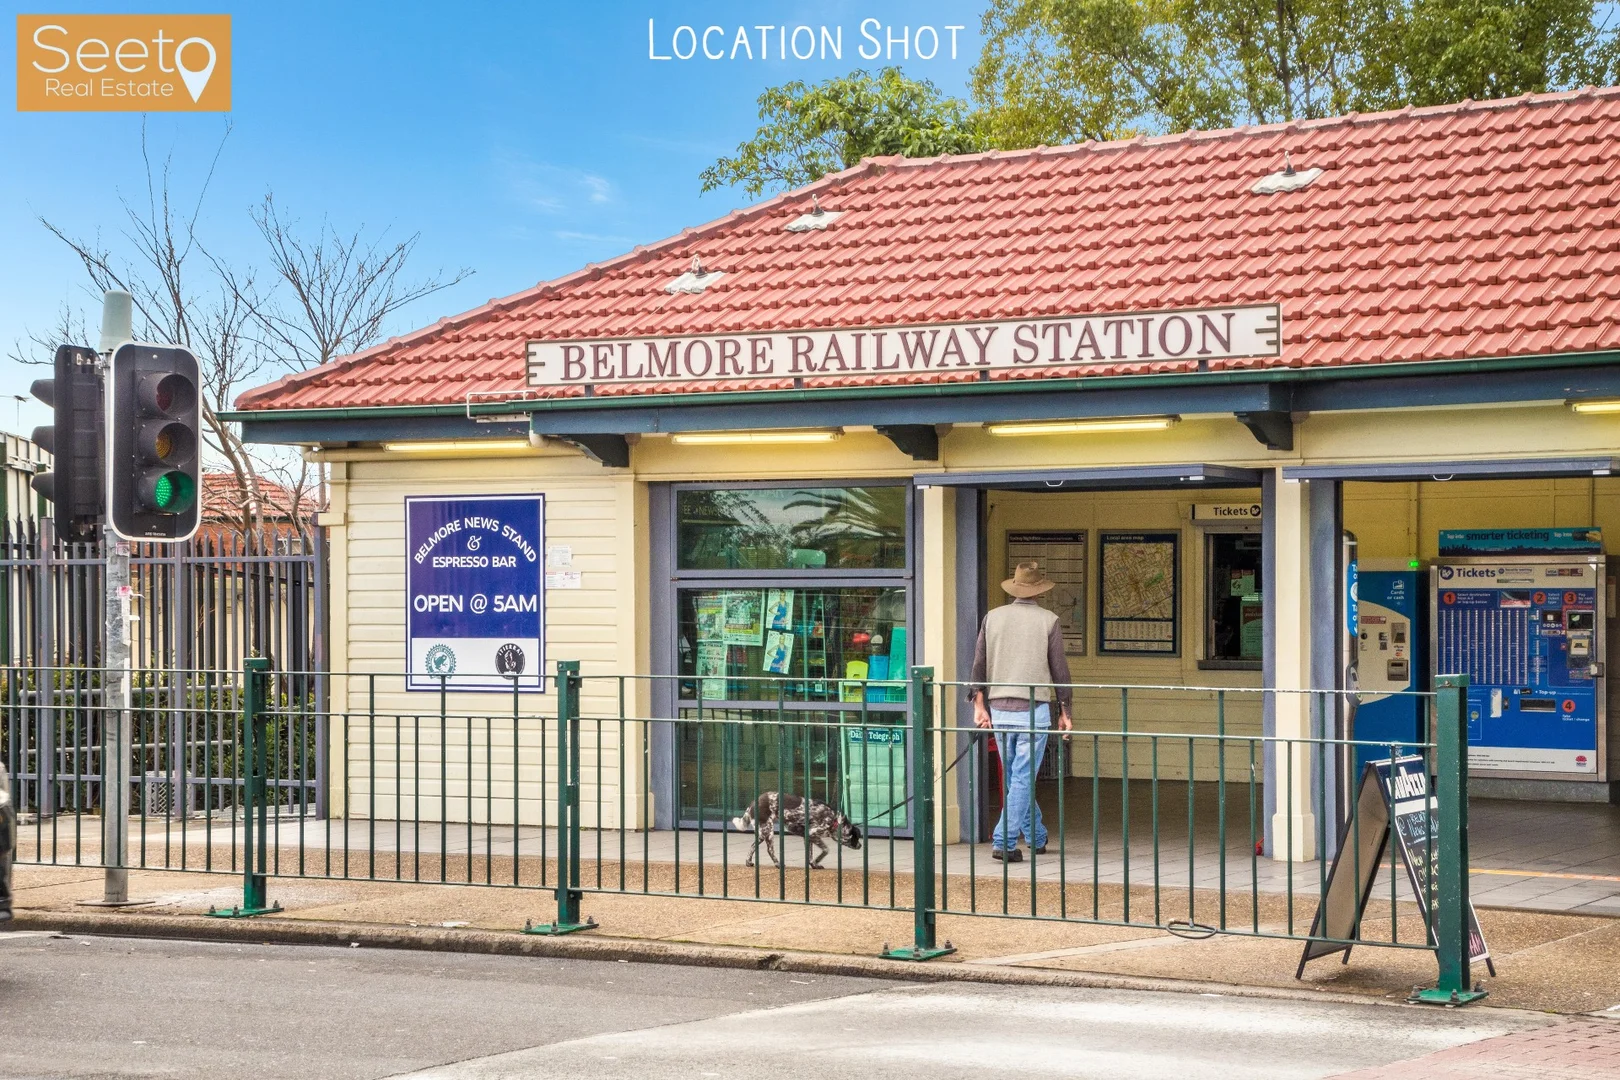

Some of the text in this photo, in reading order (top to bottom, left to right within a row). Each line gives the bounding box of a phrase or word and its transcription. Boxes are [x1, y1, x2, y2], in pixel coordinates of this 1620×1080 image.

[560, 312, 1236, 381] BELMORE RAILWAY STATION
[1213, 507, 1248, 516] Tickets
[414, 519, 462, 564] BELMORE
[464, 517, 500, 532] NEWS
[501, 525, 537, 562] STAND
[1466, 531, 1506, 541] smarter
[1506, 530, 1549, 542] ticketing
[467, 535, 482, 551] &
[432, 556, 517, 568] ESPRESSO BAR
[1456, 568, 1496, 578] Tickets
[413, 593, 537, 614] OPEN @ 5AM
[1536, 594, 1543, 602] 2
[1567, 594, 1574, 602] 3
[1565, 701, 1571, 710] 4
[869, 731, 900, 742] Telegrph
